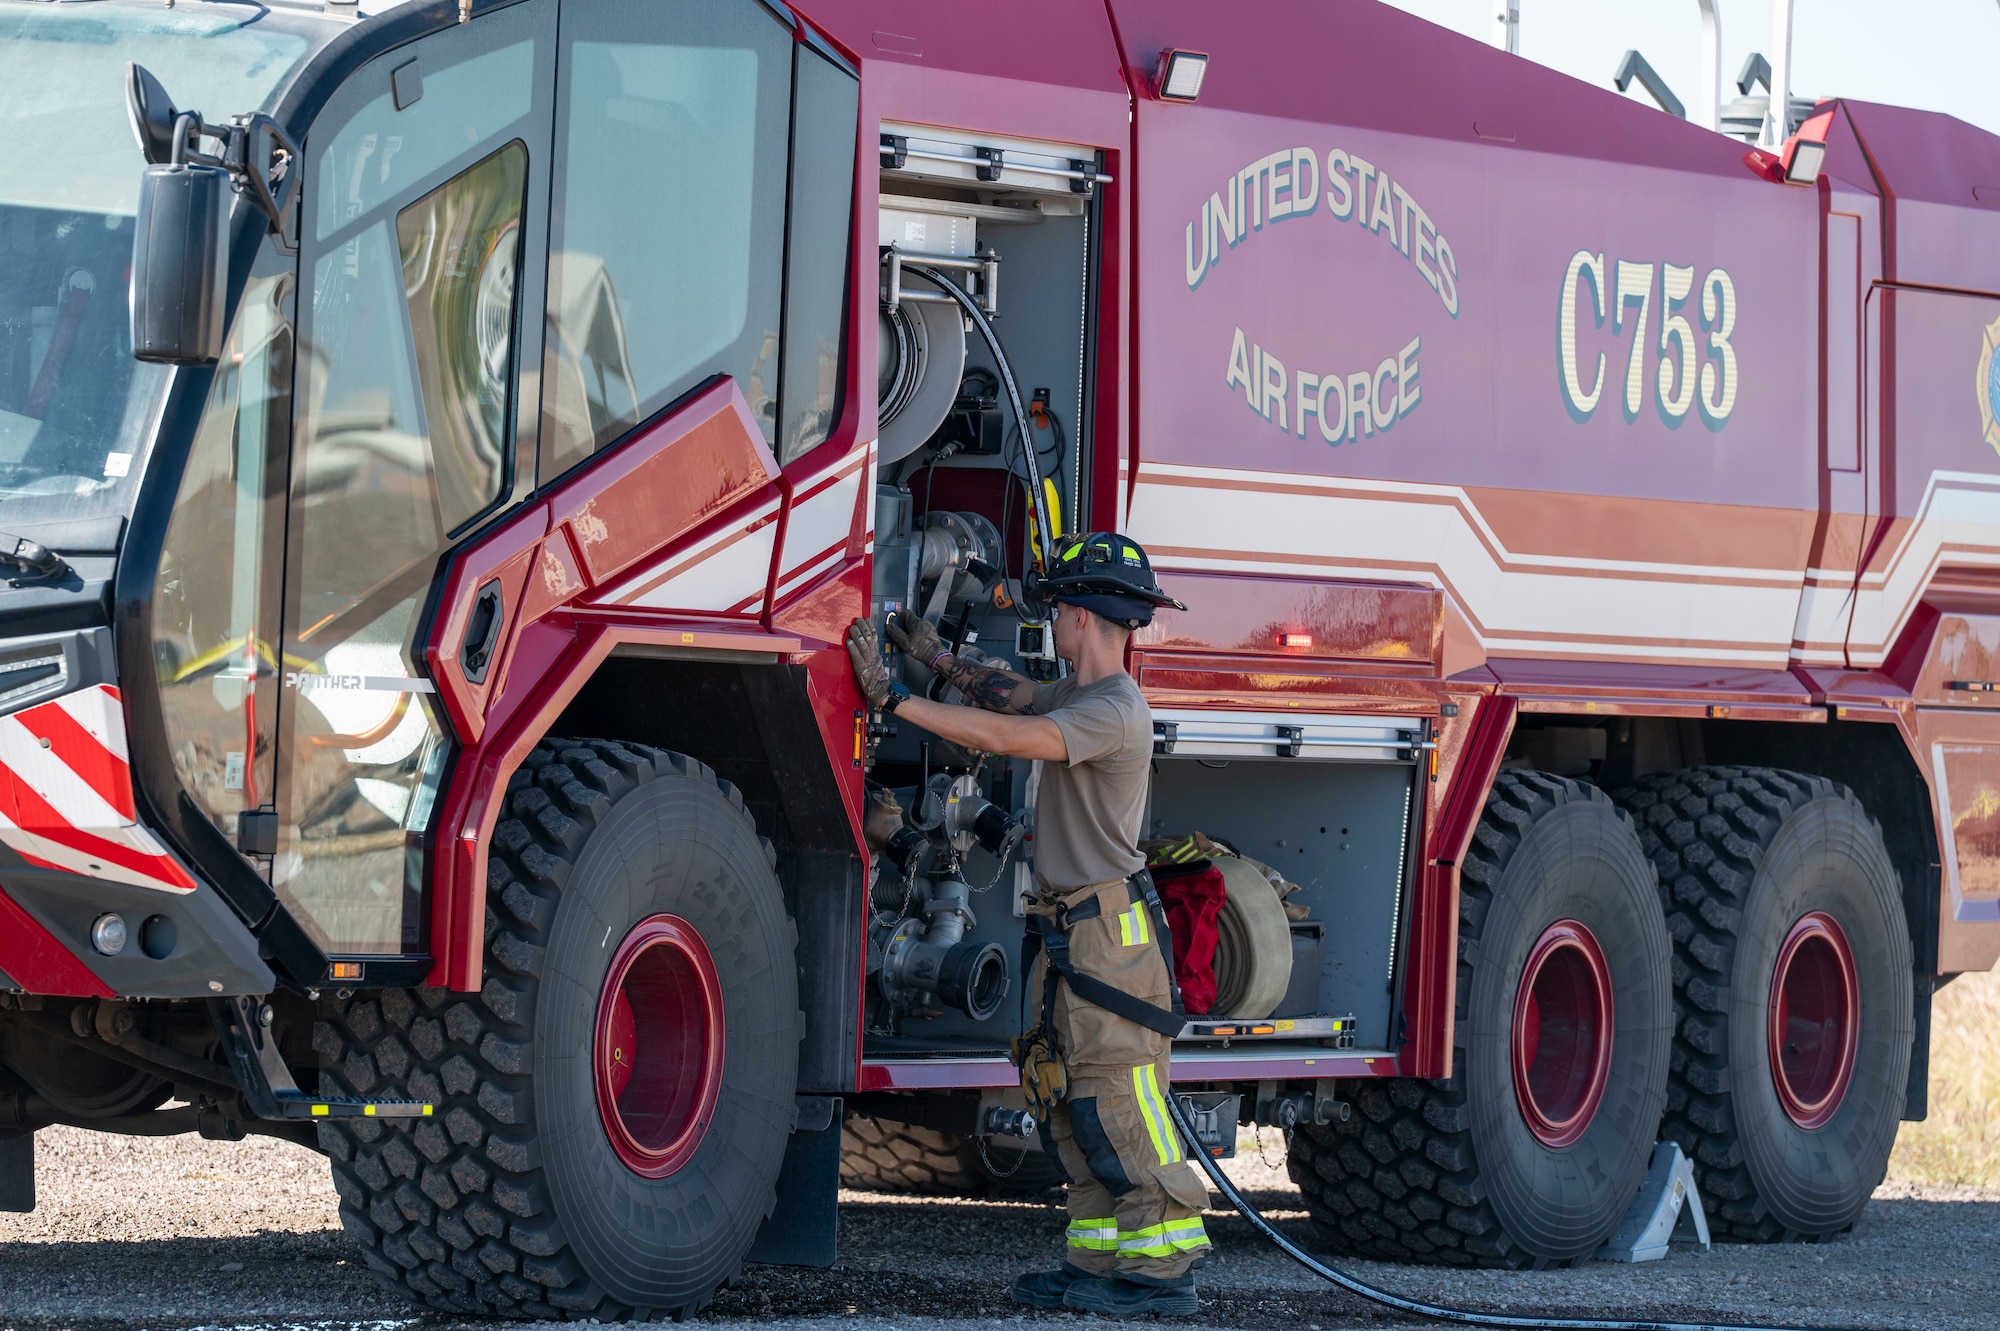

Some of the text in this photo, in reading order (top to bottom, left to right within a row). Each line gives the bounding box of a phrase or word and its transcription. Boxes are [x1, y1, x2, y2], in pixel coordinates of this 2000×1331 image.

[1185, 146, 1459, 319] UNITED STATES
[1226, 325, 1422, 447] AIR FORCE
[1556, 249, 1738, 433] C753
[286, 672, 361, 690] PANTHER
